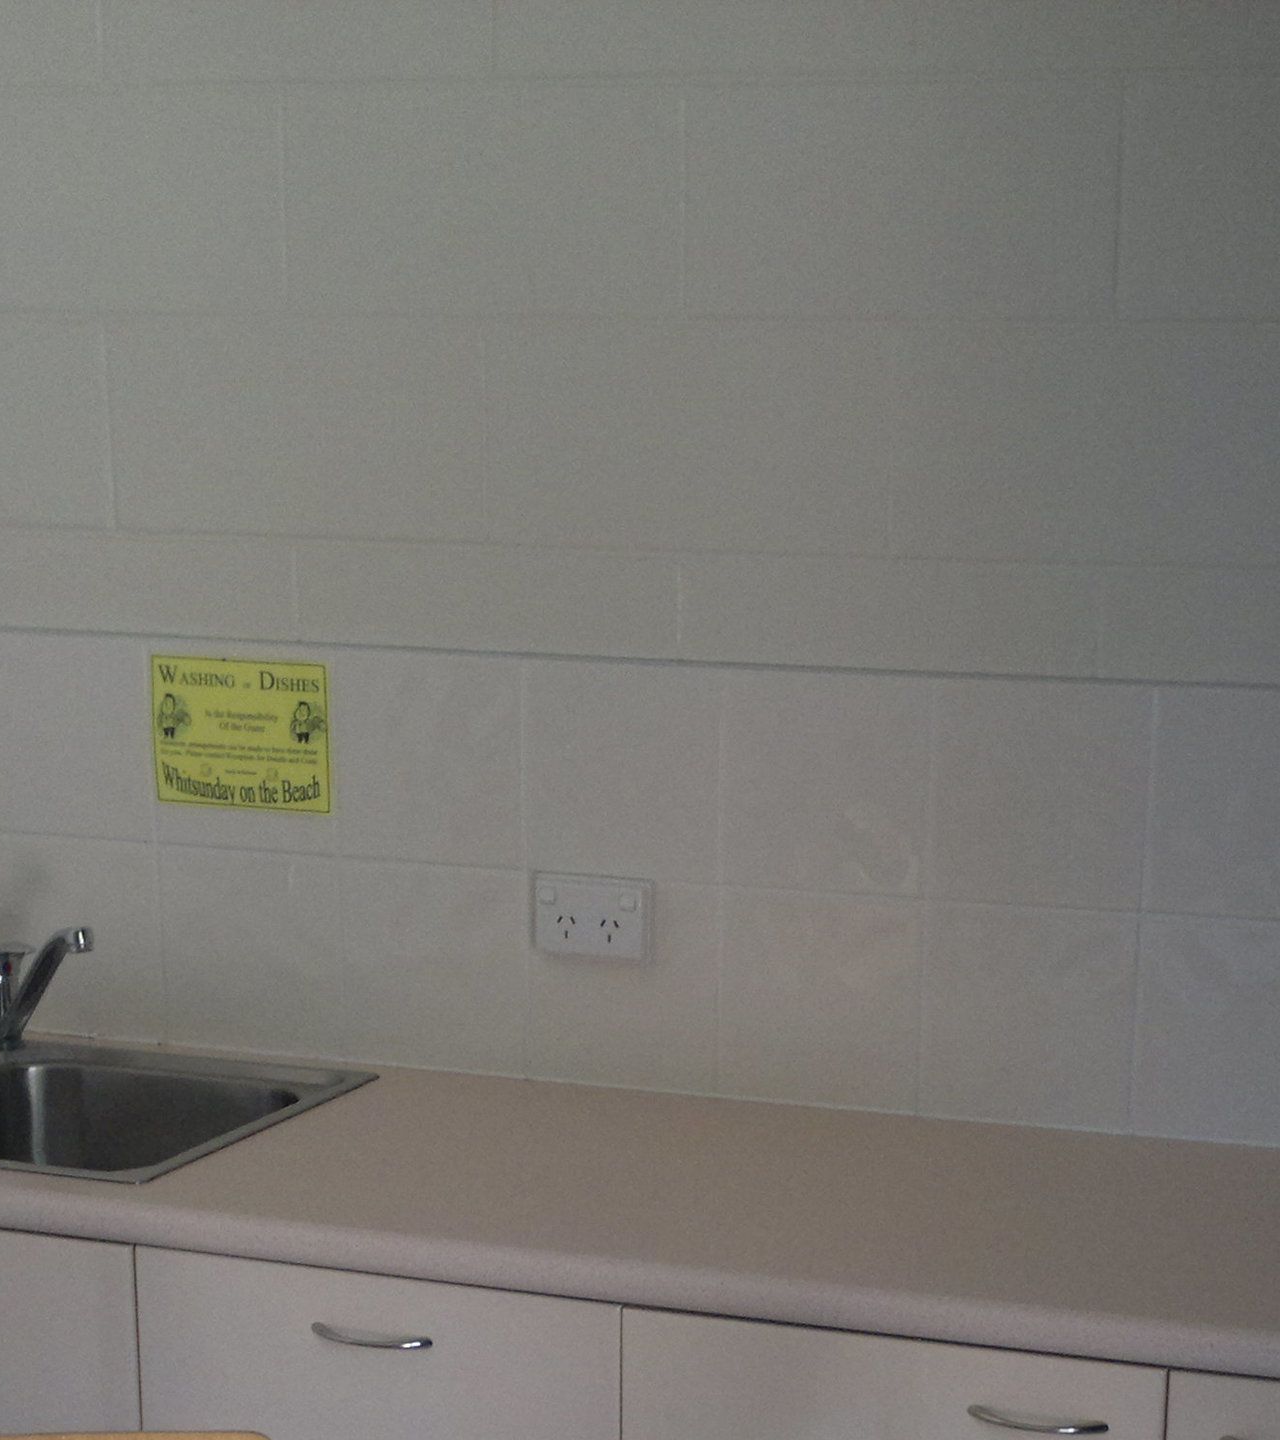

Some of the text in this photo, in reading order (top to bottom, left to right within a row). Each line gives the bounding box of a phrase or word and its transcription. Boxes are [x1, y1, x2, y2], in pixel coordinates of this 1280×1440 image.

[161, 761, 321, 804] Whitsunday on the Beach
